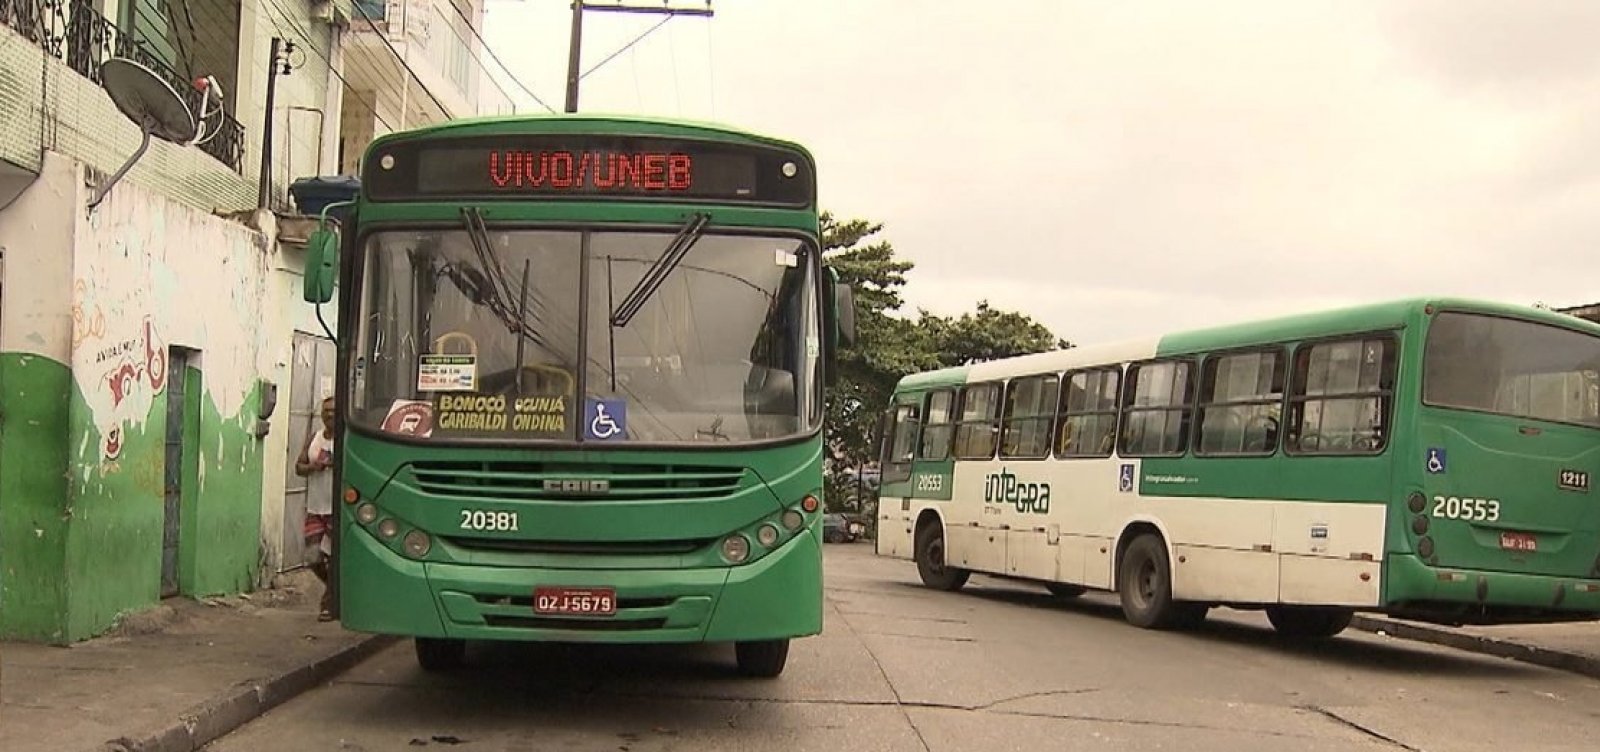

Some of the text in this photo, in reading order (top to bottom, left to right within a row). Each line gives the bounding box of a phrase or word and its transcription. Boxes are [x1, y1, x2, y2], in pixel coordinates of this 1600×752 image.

[490, 152, 691, 188] VIVO/UNEB
[439, 412, 565, 431] GARIBALDI ONDINA
[1562, 471, 1586, 487] 1211
[1433, 496, 1500, 521] 20553
[460, 510, 518, 531] 20381
